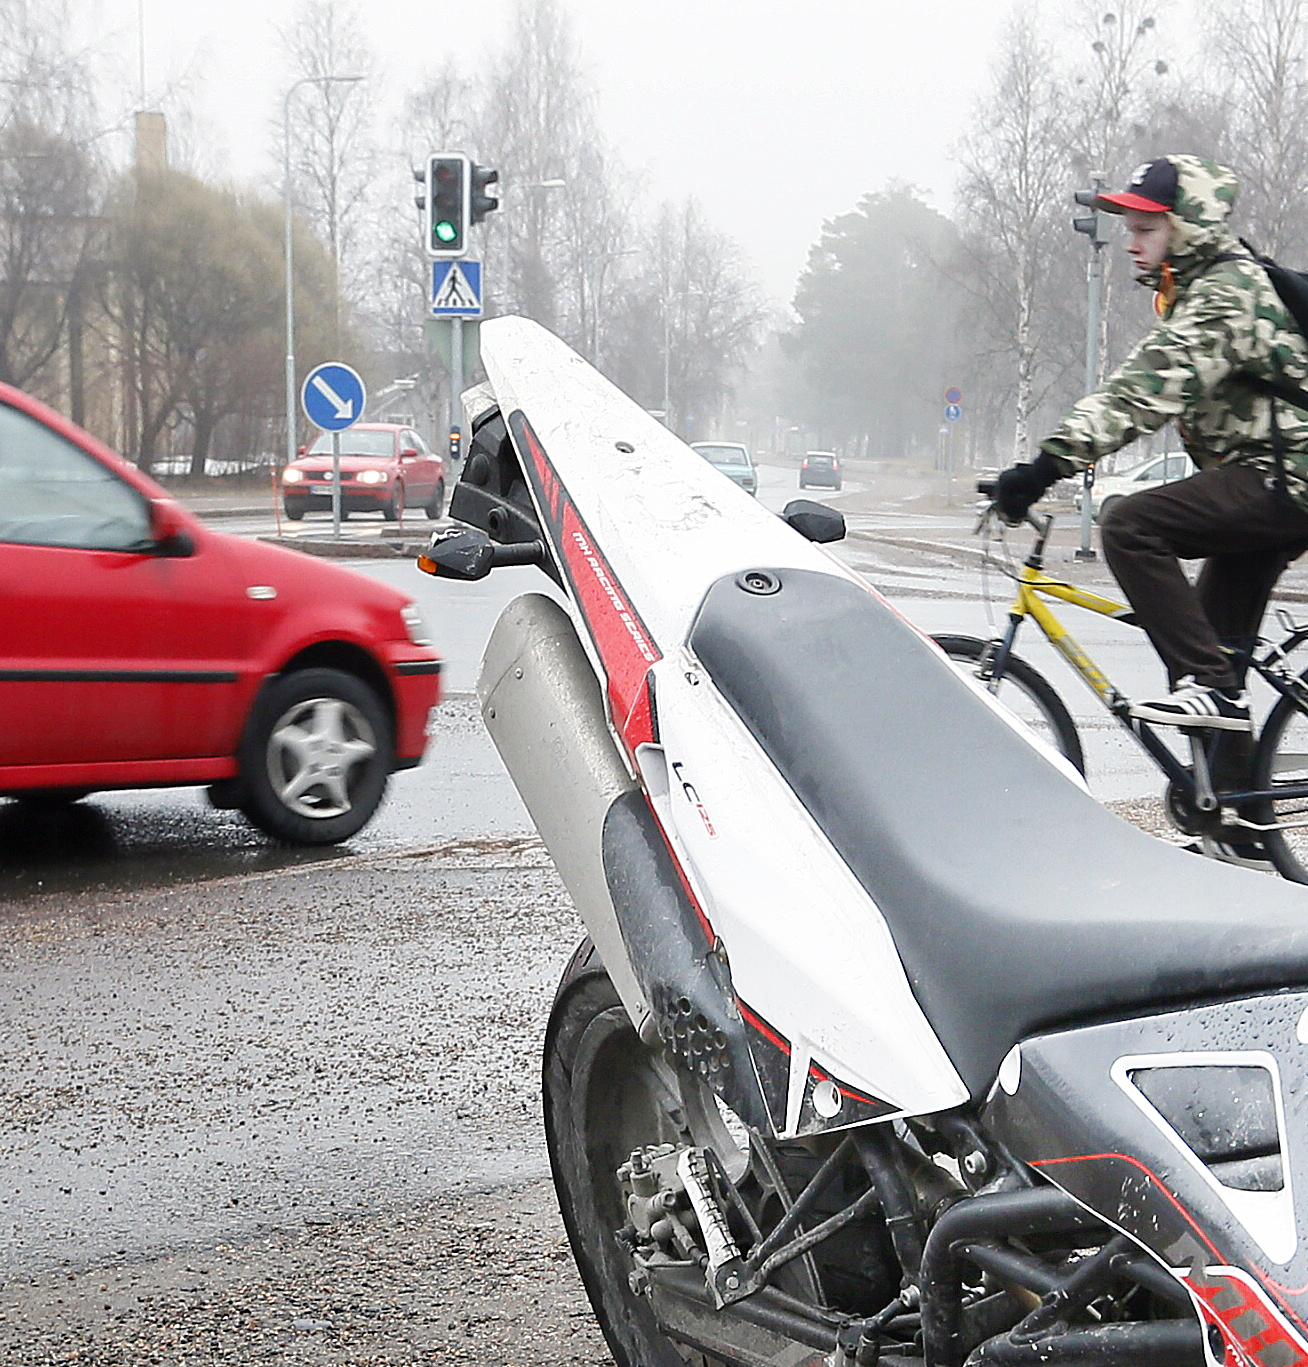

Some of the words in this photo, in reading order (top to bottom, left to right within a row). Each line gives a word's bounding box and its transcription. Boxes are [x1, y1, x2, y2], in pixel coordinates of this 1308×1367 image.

[572, 532, 593, 556] MH
[587, 557, 626, 611] RACING
[619, 612, 656, 662] SERIES
